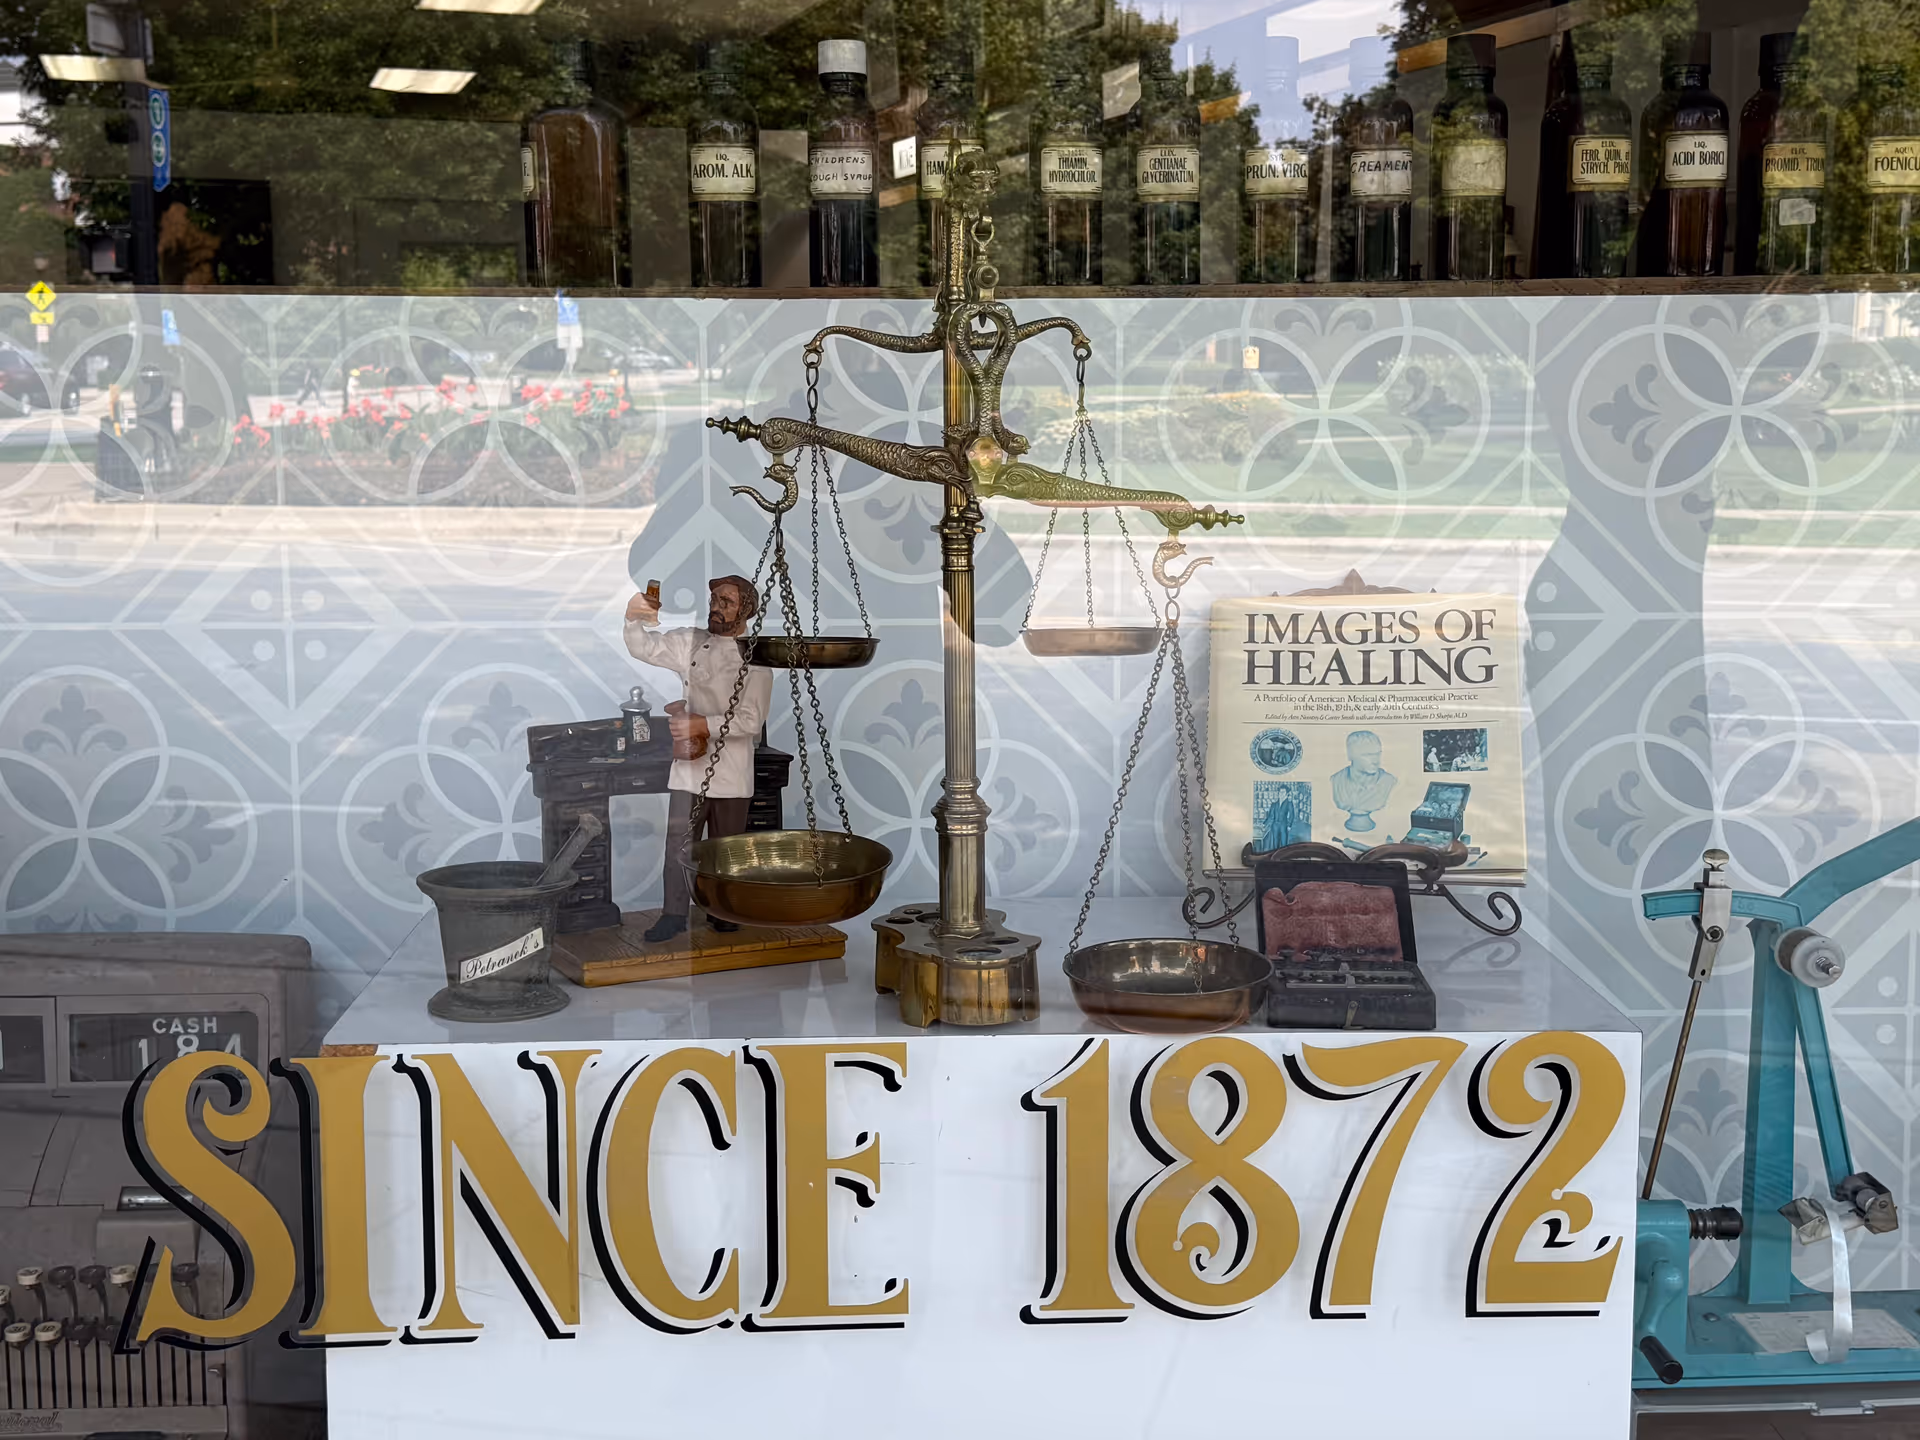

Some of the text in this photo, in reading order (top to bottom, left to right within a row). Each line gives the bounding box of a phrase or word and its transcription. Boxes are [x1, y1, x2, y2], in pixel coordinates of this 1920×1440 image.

[715, 153, 730, 162] LIQ.
[1672, 150, 1725, 166] ACIDI BORICI
[1765, 156, 1801, 172] BROMID.
[692, 163, 729, 179] AROM.
[1142, 170, 1194, 184] GLYCERINATUM
[1246, 163, 1279, 179] PRUN.
[1243, 608, 1497, 646] IMAGES OF
[1242, 646, 1499, 686] HEALING
[1254, 692, 1479, 703] A Portfolio of American Medical & Pharmaceutical Practice
[1293, 703, 1302, 711] in
[1302, 703, 1315, 711] the
[1354, 703, 1361, 711] &
[1362, 703, 1381, 714] early
[465, 933, 540, 979] Petranek's
[152, 1016, 218, 1035] CASH
[114, 1030, 1626, 1355] SINCE 1872
